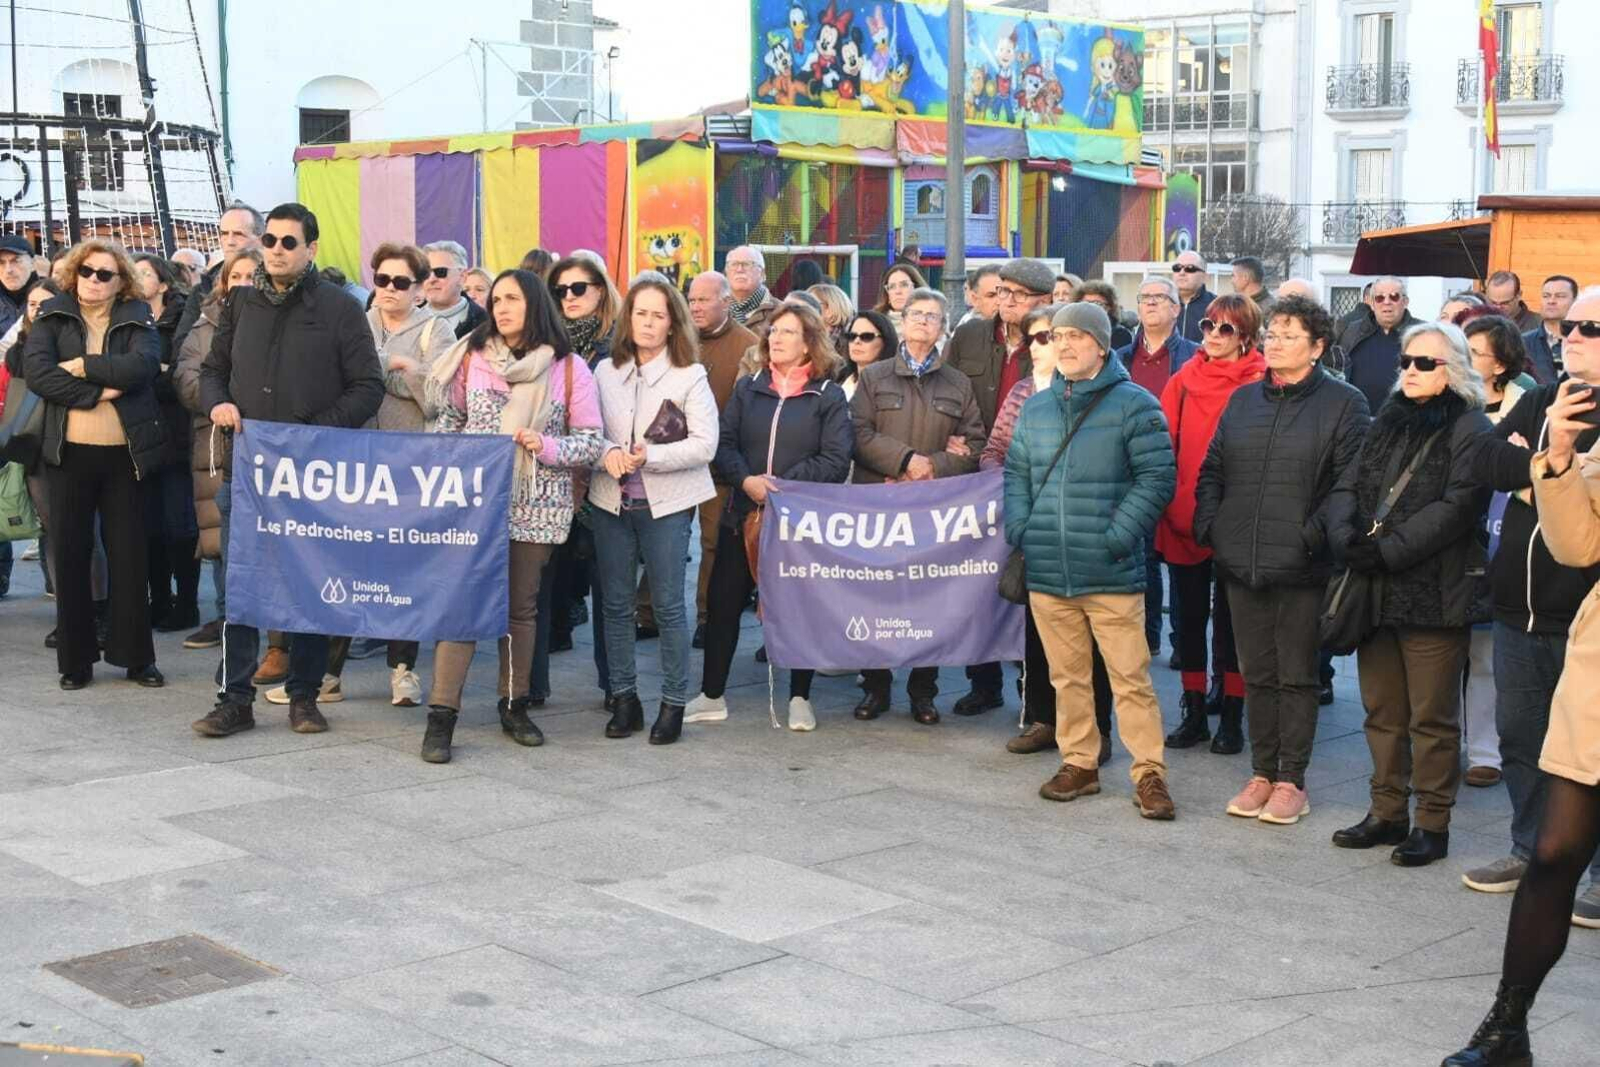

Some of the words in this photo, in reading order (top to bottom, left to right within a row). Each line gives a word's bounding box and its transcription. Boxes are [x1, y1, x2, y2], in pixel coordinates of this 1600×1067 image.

[254, 454, 399, 506] ¡AGUA
[412, 465, 483, 508] YA!
[285, 521, 373, 543] Pedroches
[389, 528, 405, 544] El
[408, 528, 478, 545] Guadiato
[779, 507, 915, 548] ¡AGUA
[930, 500, 997, 544] YA!
[779, 562, 806, 578] Los
[810, 562, 894, 581] Pedroches
[908, 564, 923, 579] El
[927, 558, 998, 578] Guadiato
[353, 580, 389, 593] Unidos
[352, 592, 371, 605] por
[373, 592, 383, 603] el
[385, 593, 412, 606] Agua
[875, 618, 911, 629] Unidos
[875, 629, 894, 639] por
[895, 629, 905, 638] el
[907, 628, 933, 640] Agua
